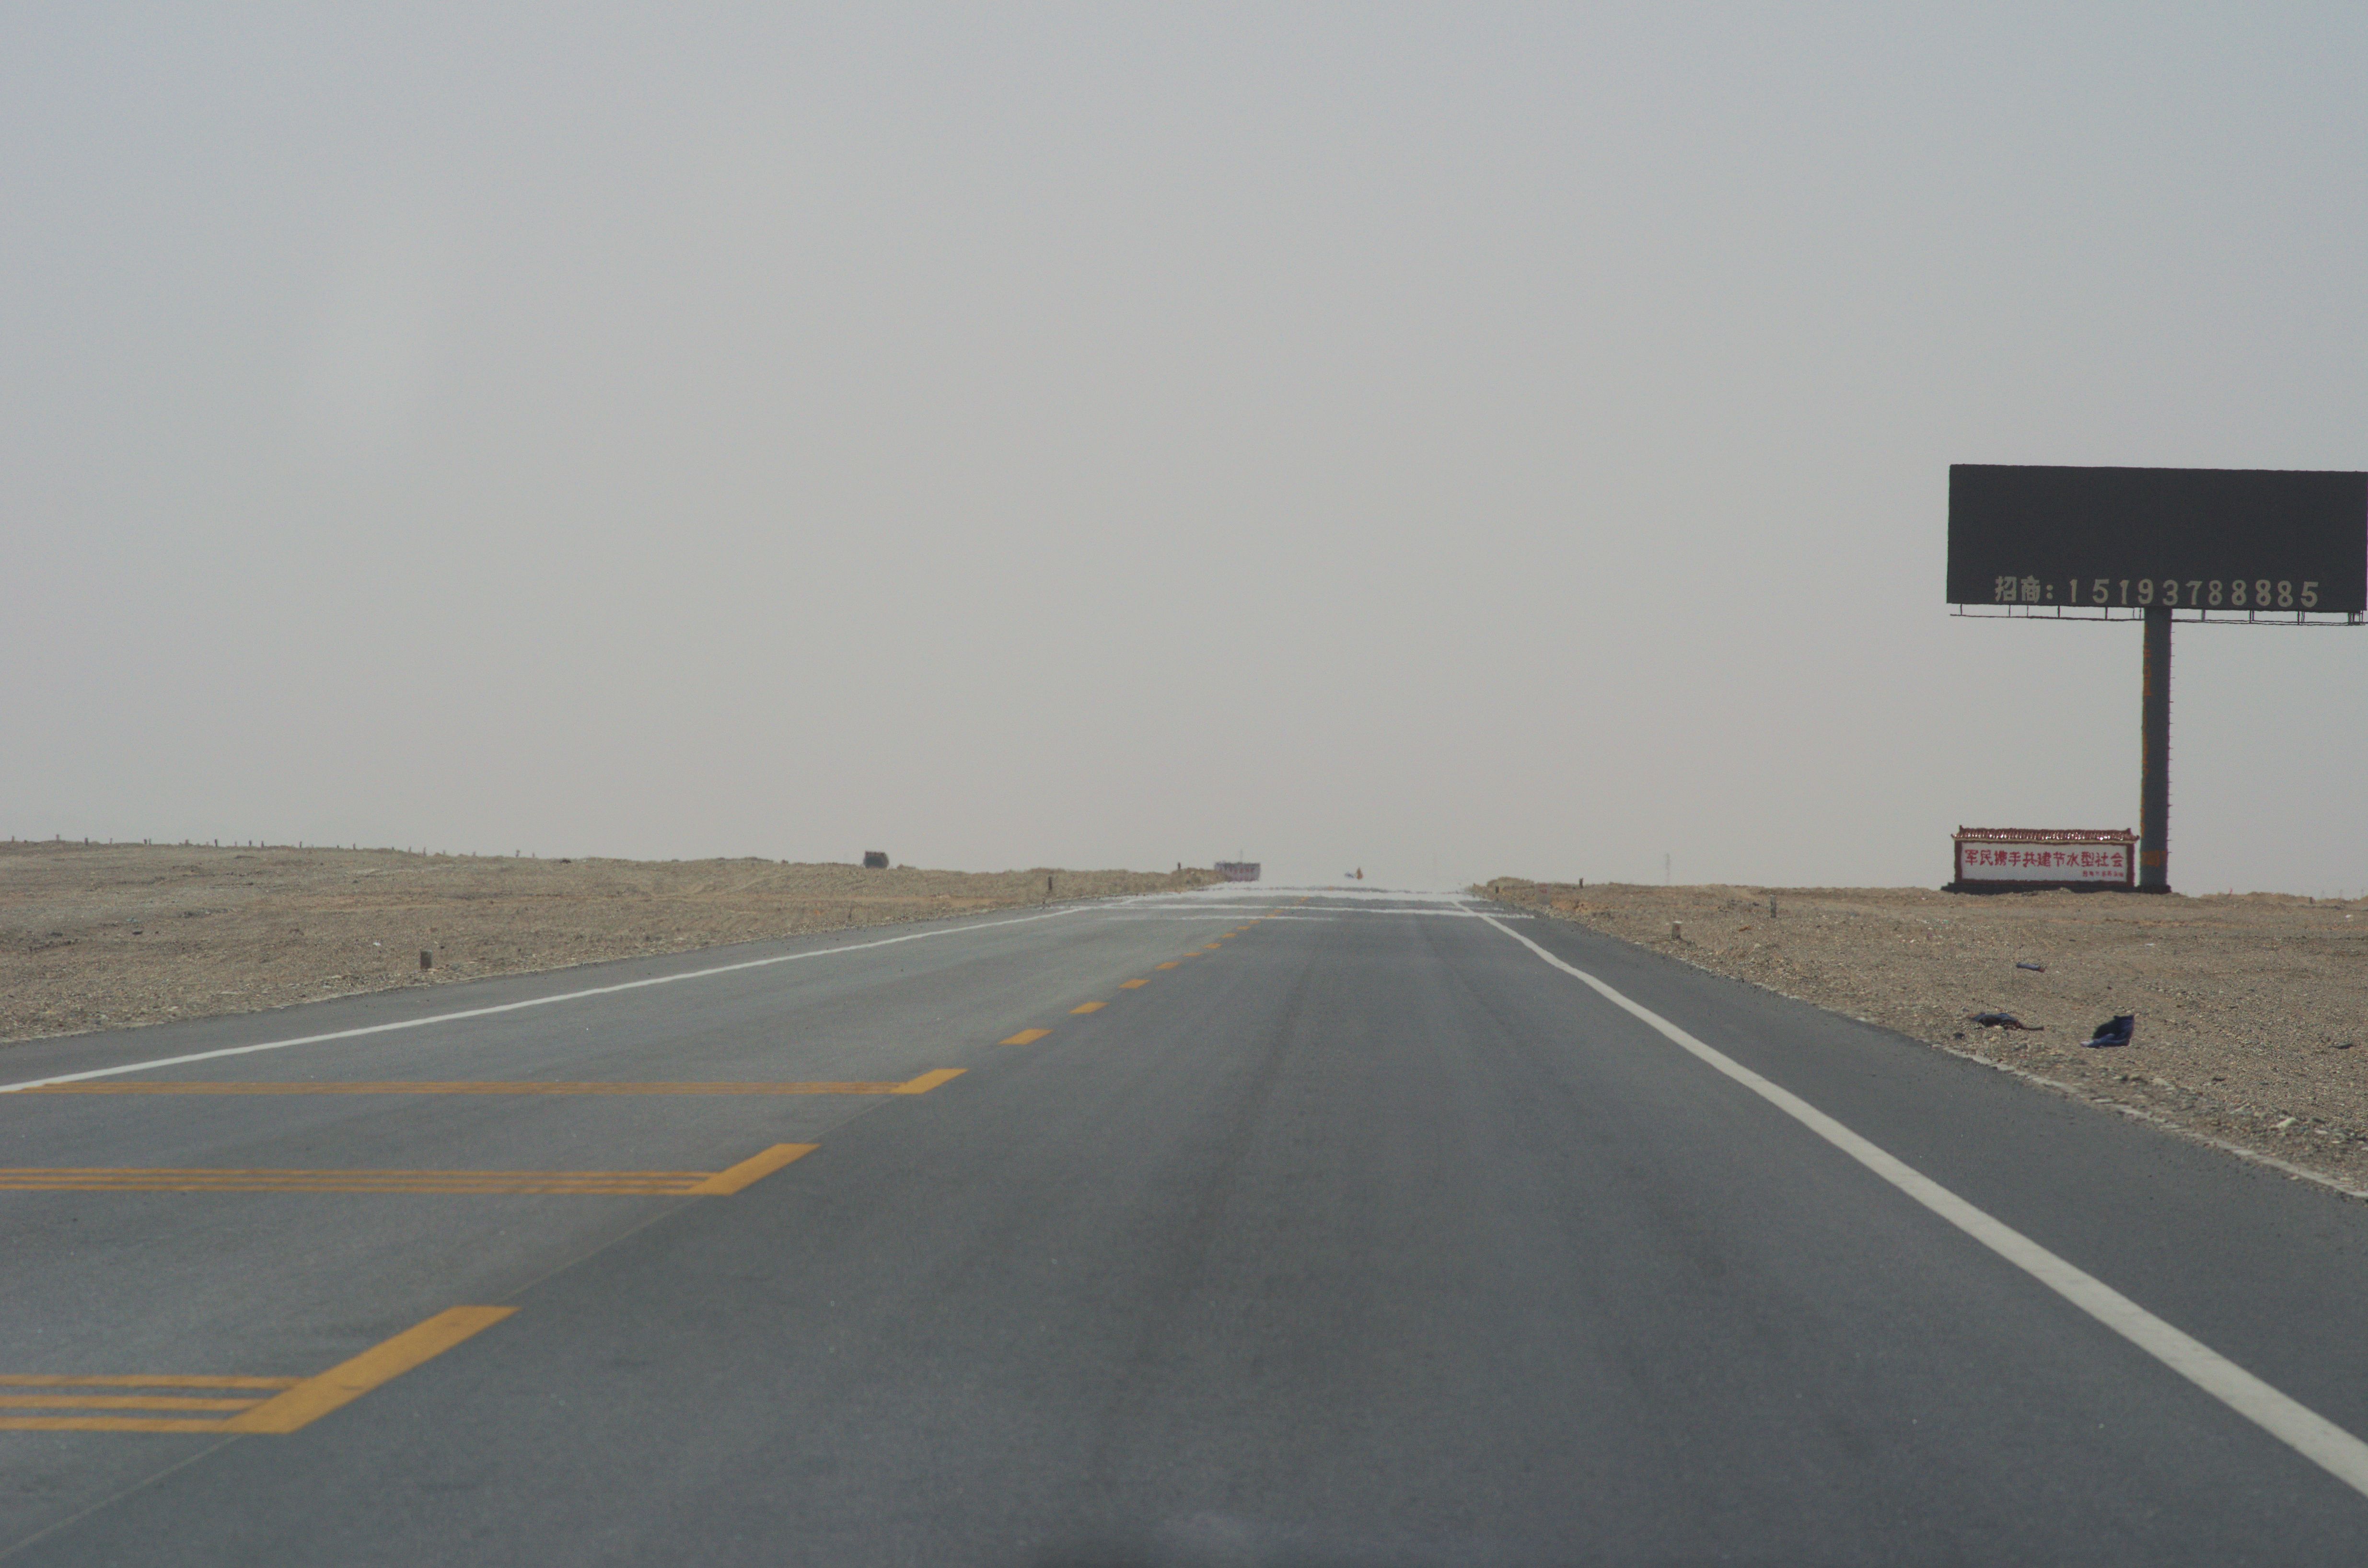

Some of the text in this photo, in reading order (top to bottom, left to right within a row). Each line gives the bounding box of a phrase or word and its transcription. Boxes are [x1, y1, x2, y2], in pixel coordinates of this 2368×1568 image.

[1964, 849, 2124, 867] 军民携手共建节水型社会
